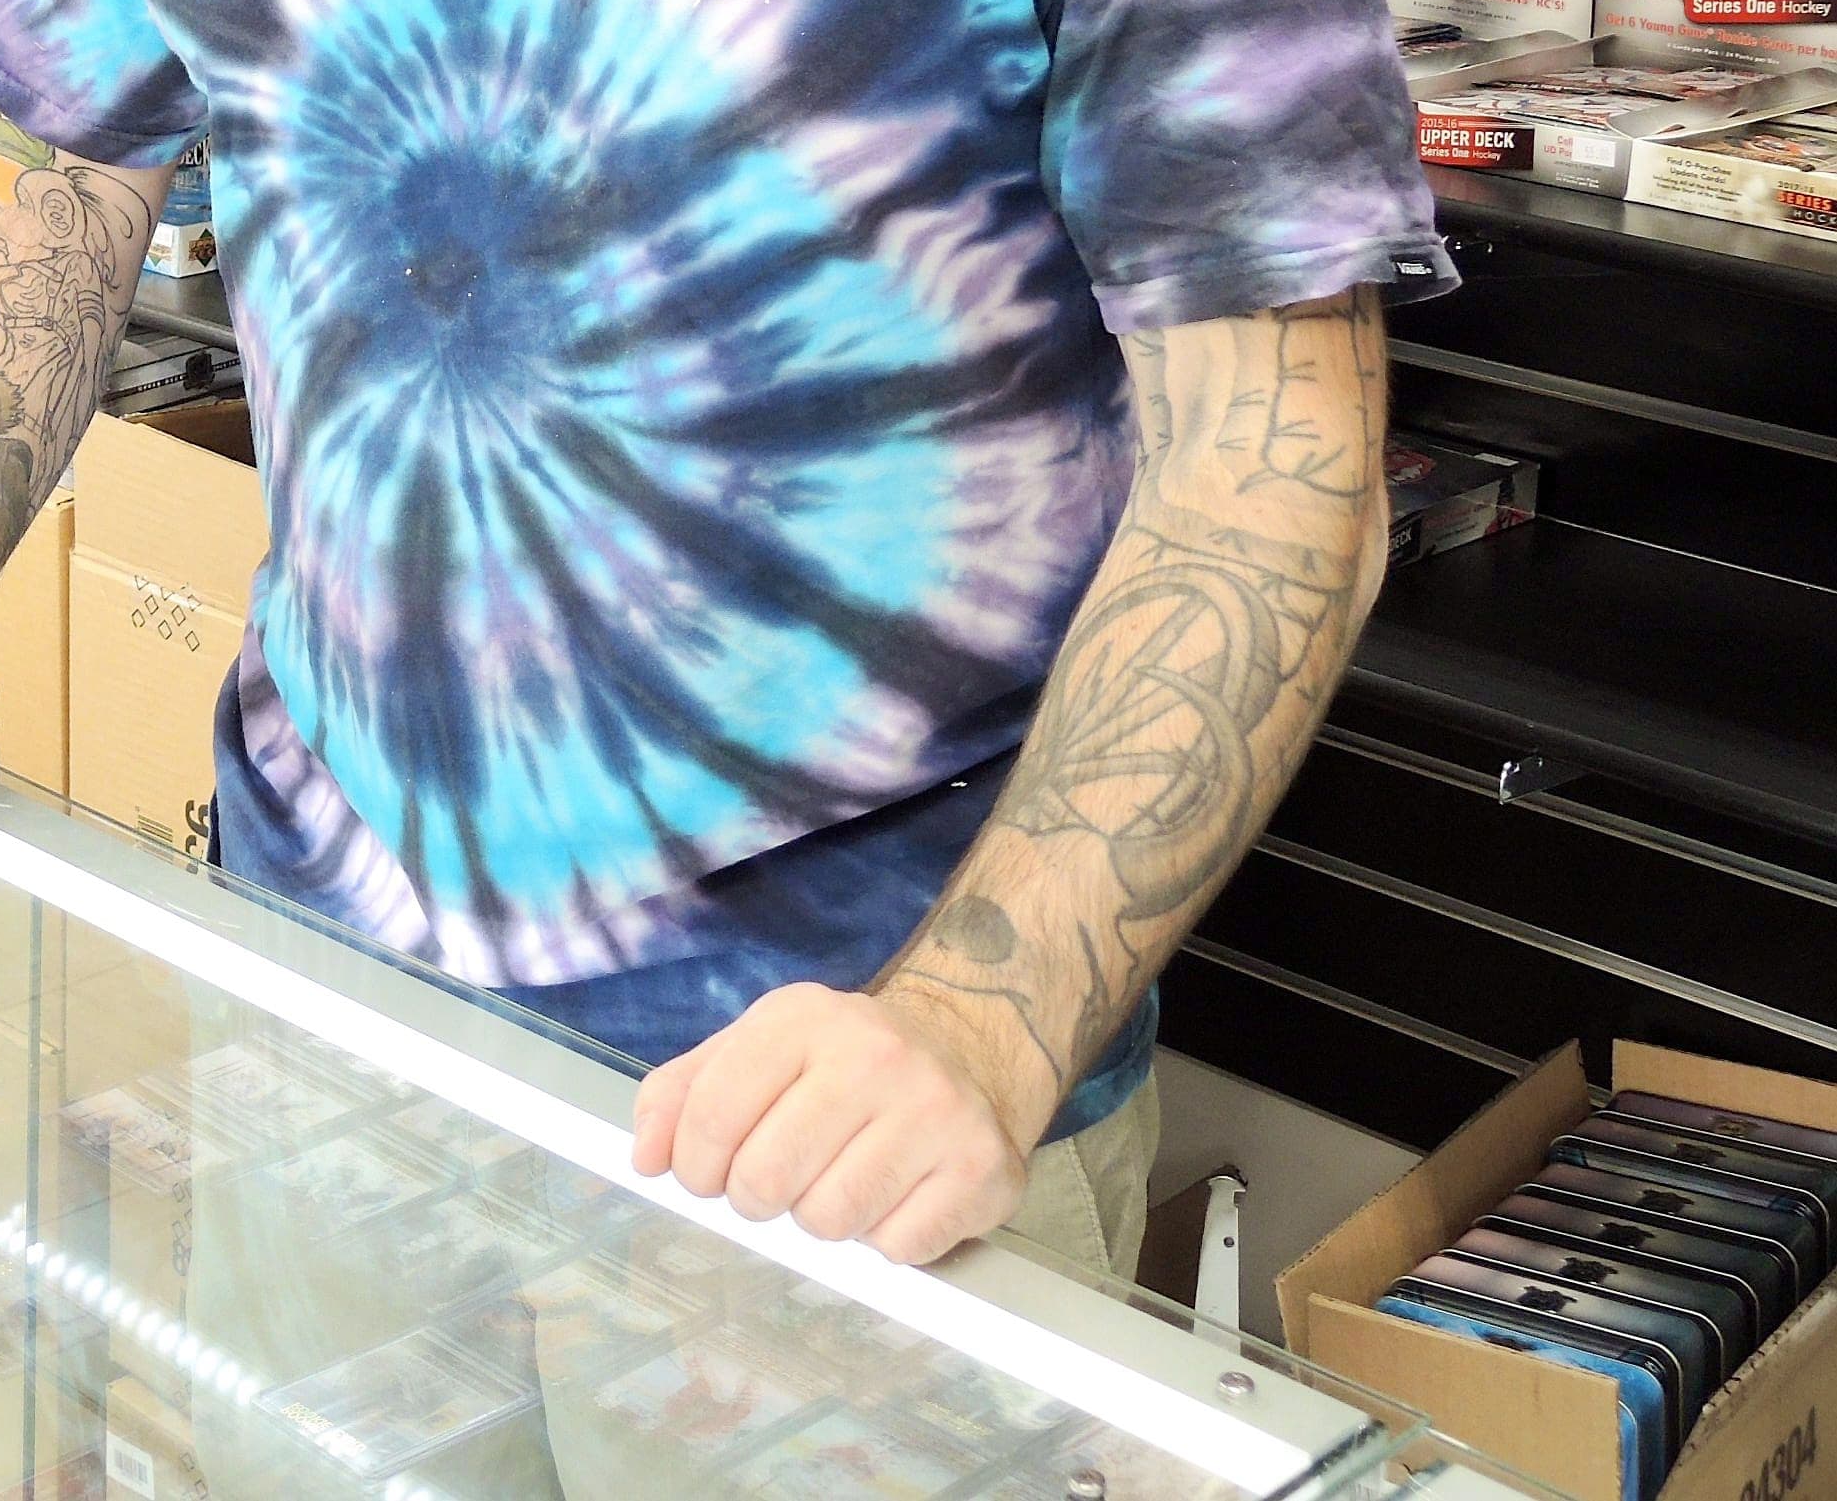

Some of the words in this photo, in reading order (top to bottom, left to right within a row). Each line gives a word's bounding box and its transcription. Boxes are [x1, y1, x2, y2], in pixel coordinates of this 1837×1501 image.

[1781, 0, 1832, 18] Hockey
[1628, 16, 1637, 28] 6
[1639, 18, 1674, 36] Young
[1421, 117, 1458, 129] 2015-16
[1420, 128, 1470, 148] UPPER
[1474, 130, 1516, 149] DECK
[1421, 146, 1450, 159] Series
[1452, 147, 1470, 159] One
[1472, 150, 1502, 162] Hockey
[1777, 190, 1833, 211] SERIES
